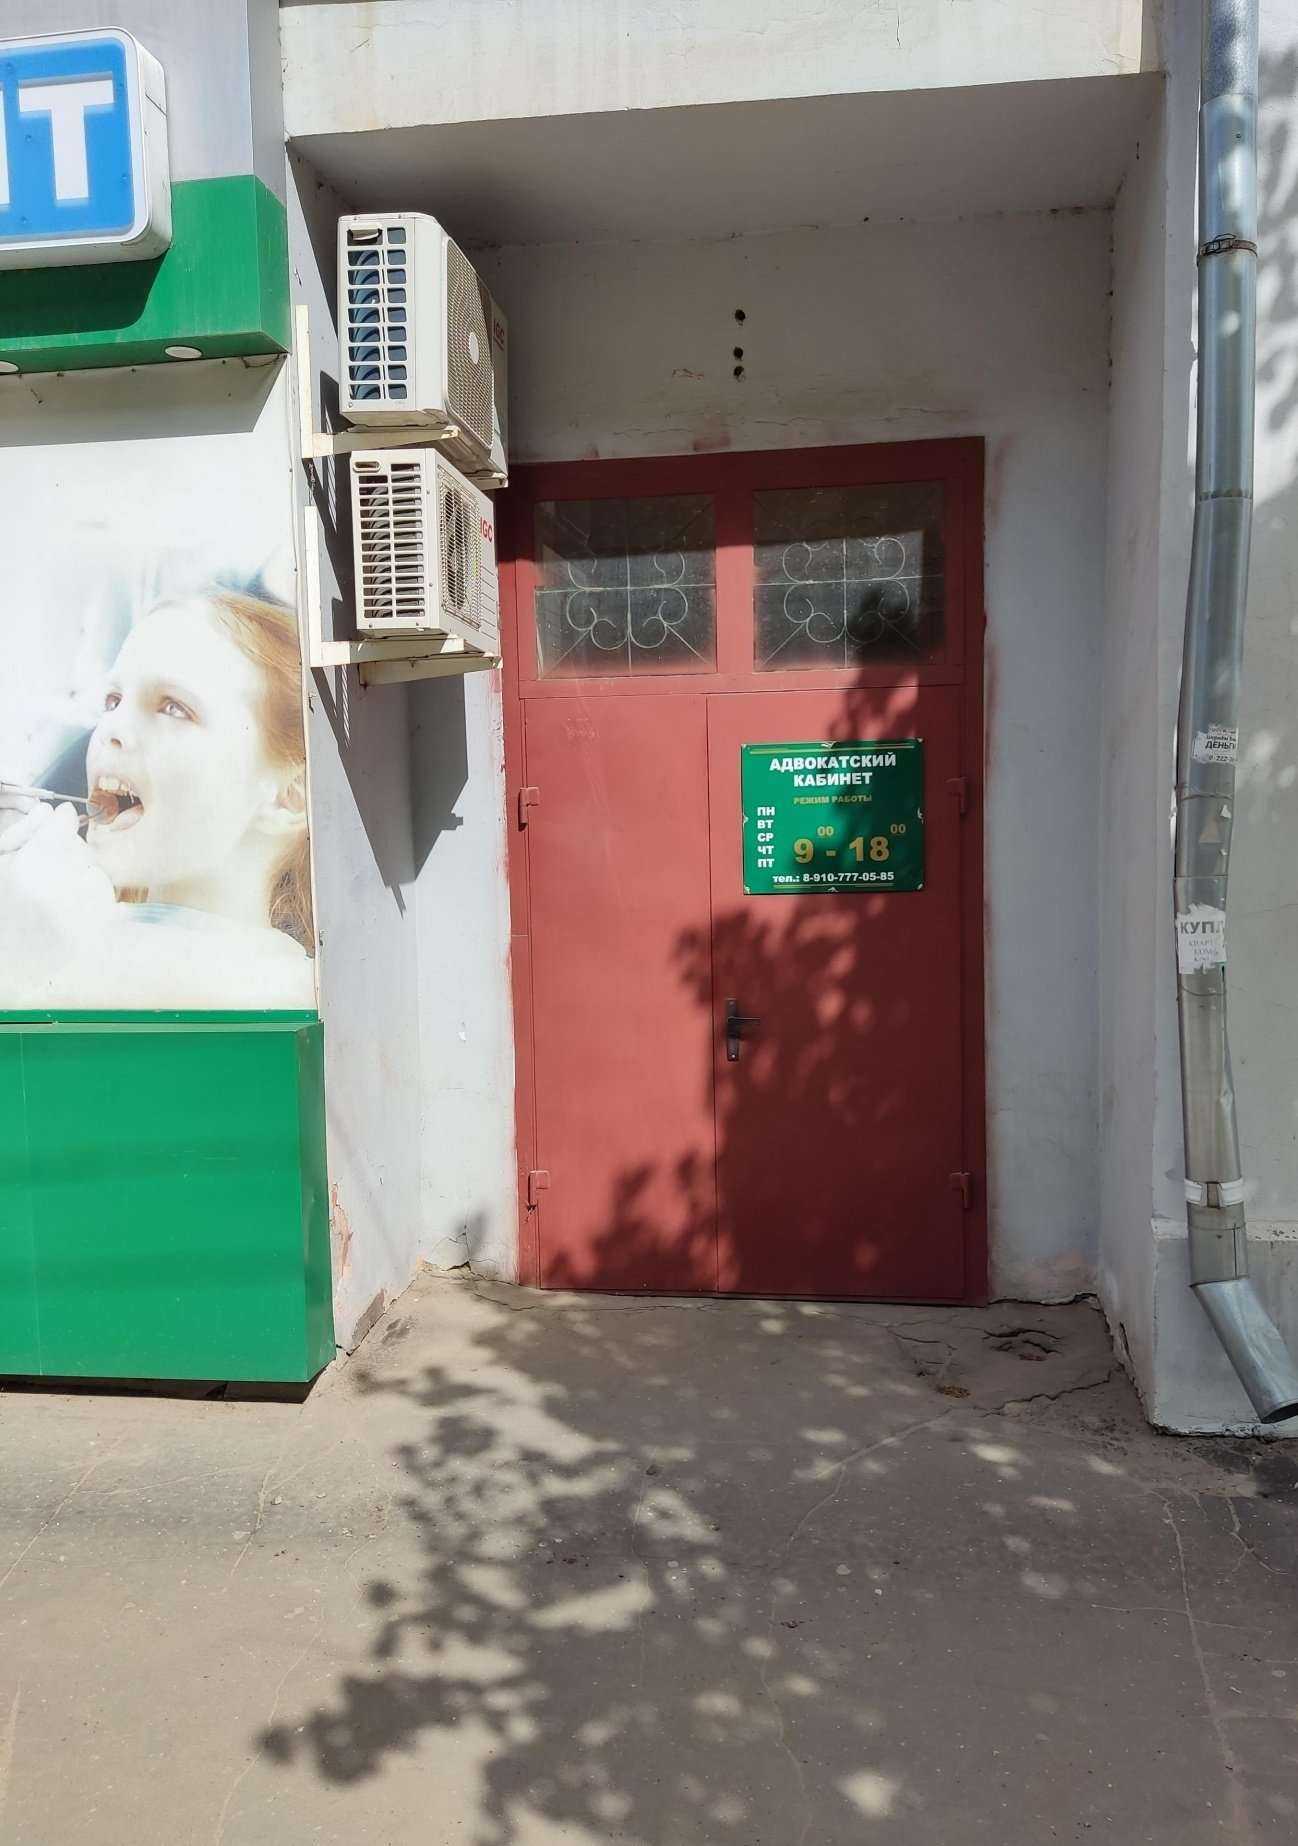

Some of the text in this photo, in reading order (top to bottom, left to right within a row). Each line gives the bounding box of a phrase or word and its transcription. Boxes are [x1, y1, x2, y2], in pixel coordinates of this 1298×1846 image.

[480, 516, 493, 542] IGC
[769, 752, 896, 773] АДВОКАТСКИЙ
[793, 772, 873, 787] КАБИНЕТ
[794, 794, 873, 804] РЕЖИМ РАБОТЫ
[757, 806, 775, 816] ПН
[757, 819, 774, 829] ВТ
[757, 833, 774, 842] СР
[757, 845, 775, 855] ЧТ
[849, 836, 890, 862] 18
[757, 858, 775, 868] ПТ
[802, 871, 895, 882] 8-910-777-05-85
